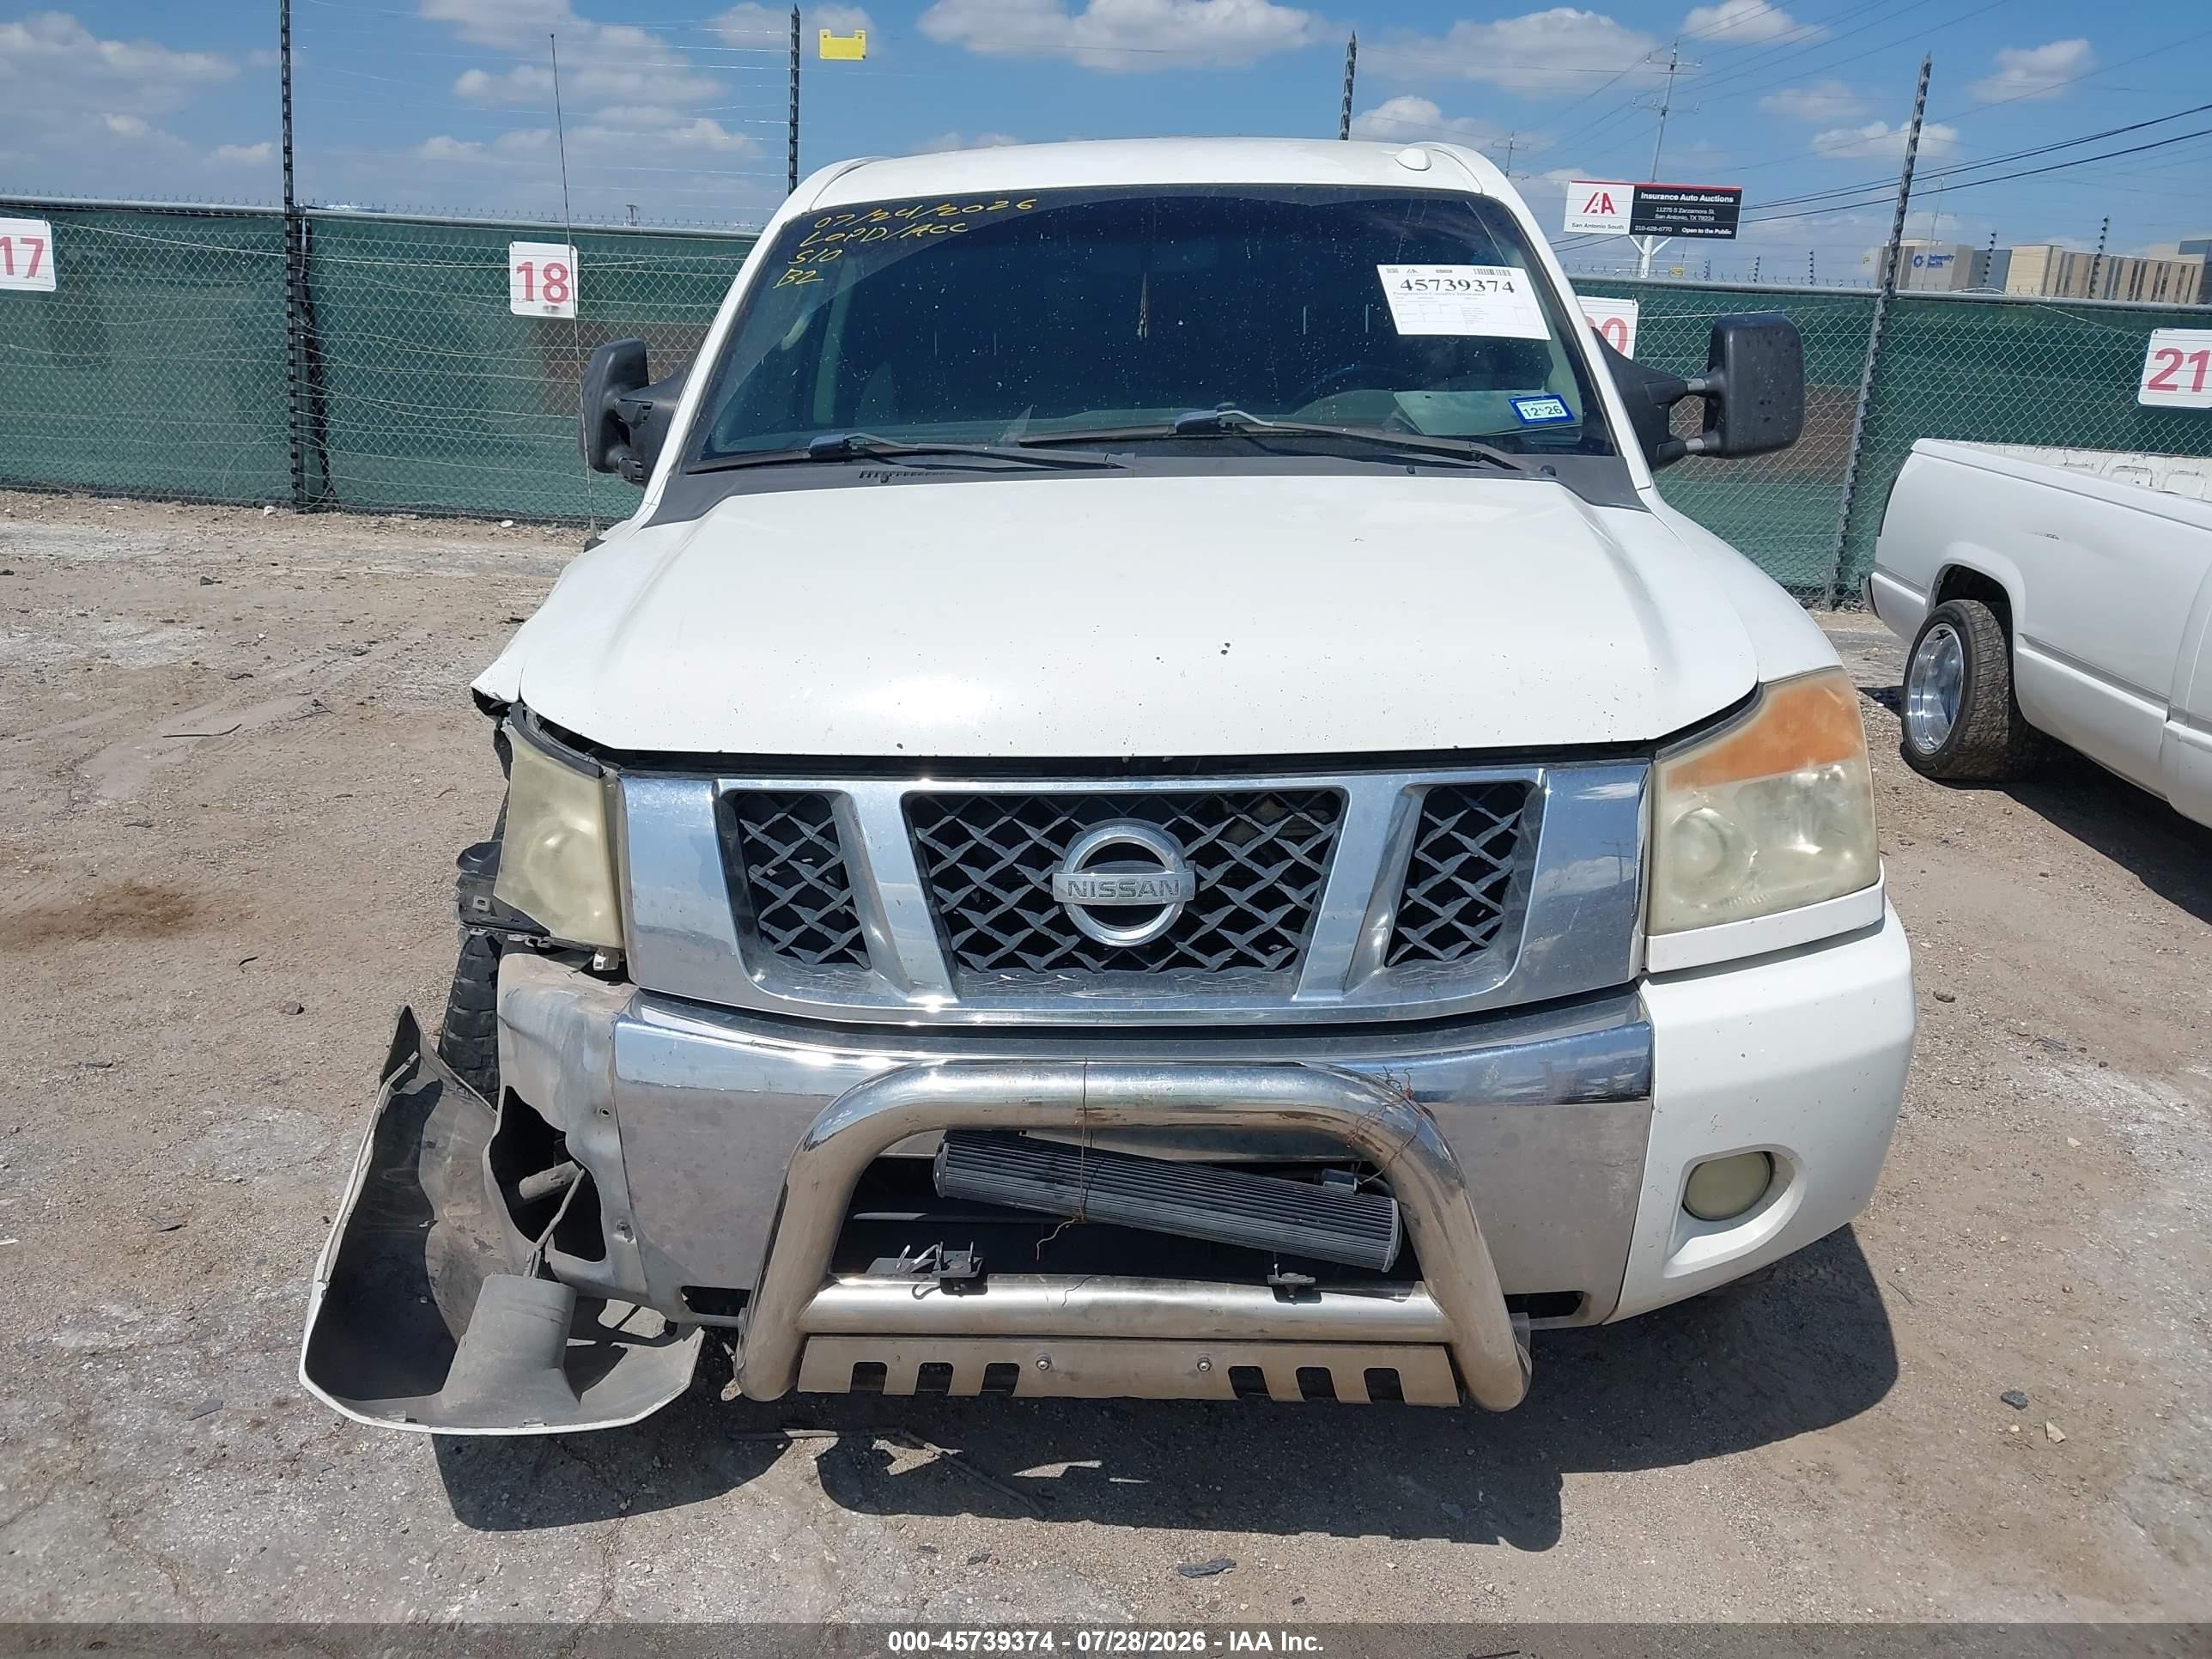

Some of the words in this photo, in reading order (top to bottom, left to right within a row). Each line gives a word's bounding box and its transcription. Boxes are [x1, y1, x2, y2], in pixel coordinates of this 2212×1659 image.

[813, 199, 1037, 228] 07/24/2026
[1641, 191, 1679, 201] Insurance
[1680, 193, 1698, 202] Auto
[1699, 194, 1735, 203] Auctions
[0, 236, 45, 277] 17
[516, 261, 568, 303] 18
[1400, 279, 1516, 293] 45739374
[1584, 316, 1627, 353] 0
[2148, 348, 2210, 392] 21
[1066, 878, 1181, 899] NISSAN
